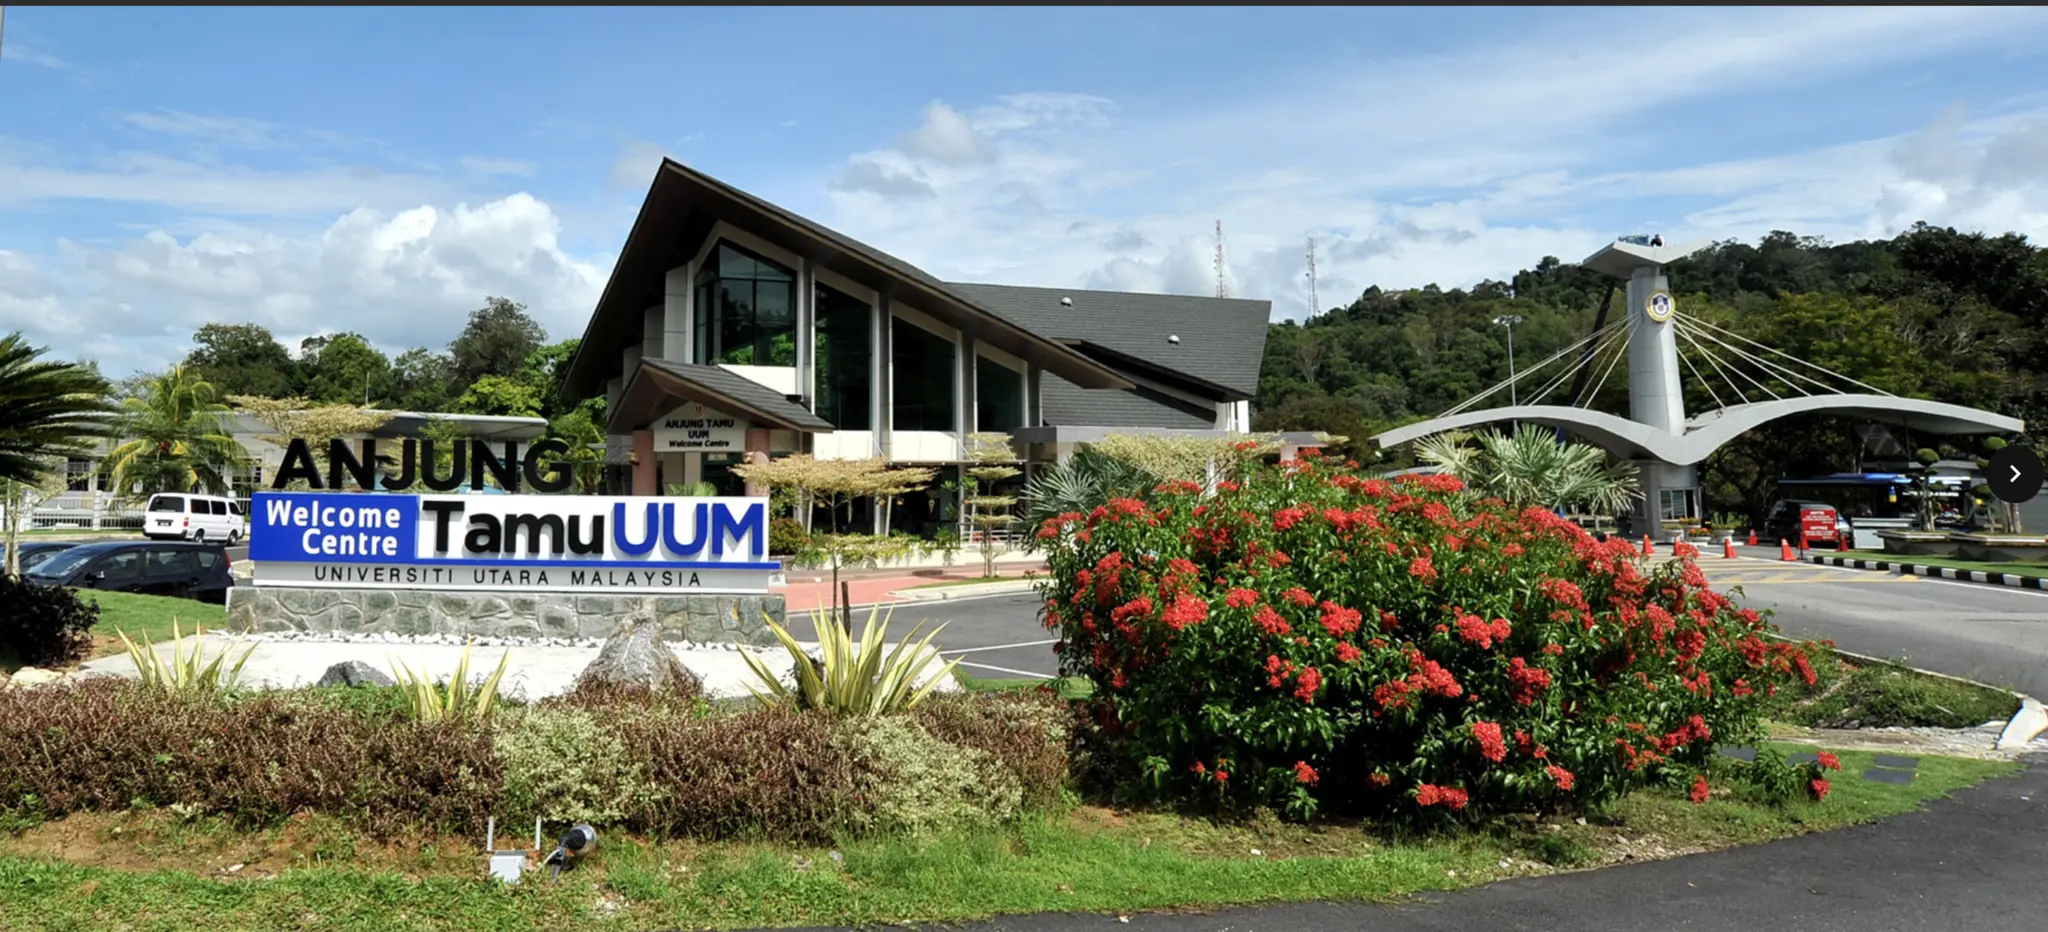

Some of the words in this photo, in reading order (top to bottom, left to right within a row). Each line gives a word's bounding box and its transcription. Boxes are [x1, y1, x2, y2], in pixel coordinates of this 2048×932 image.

[664, 419, 703, 428] ANJUNG
[706, 419, 734, 428] TAMU
[688, 430, 709, 439] UUM
[271, 438, 573, 492] ANJUNG
[266, 500, 400, 528] Welcome
[302, 528, 398, 556] Centre
[315, 566, 452, 583] UNIVERSITI
[473, 569, 549, 585] UTARA
[571, 570, 701, 587] MALAYSIA
